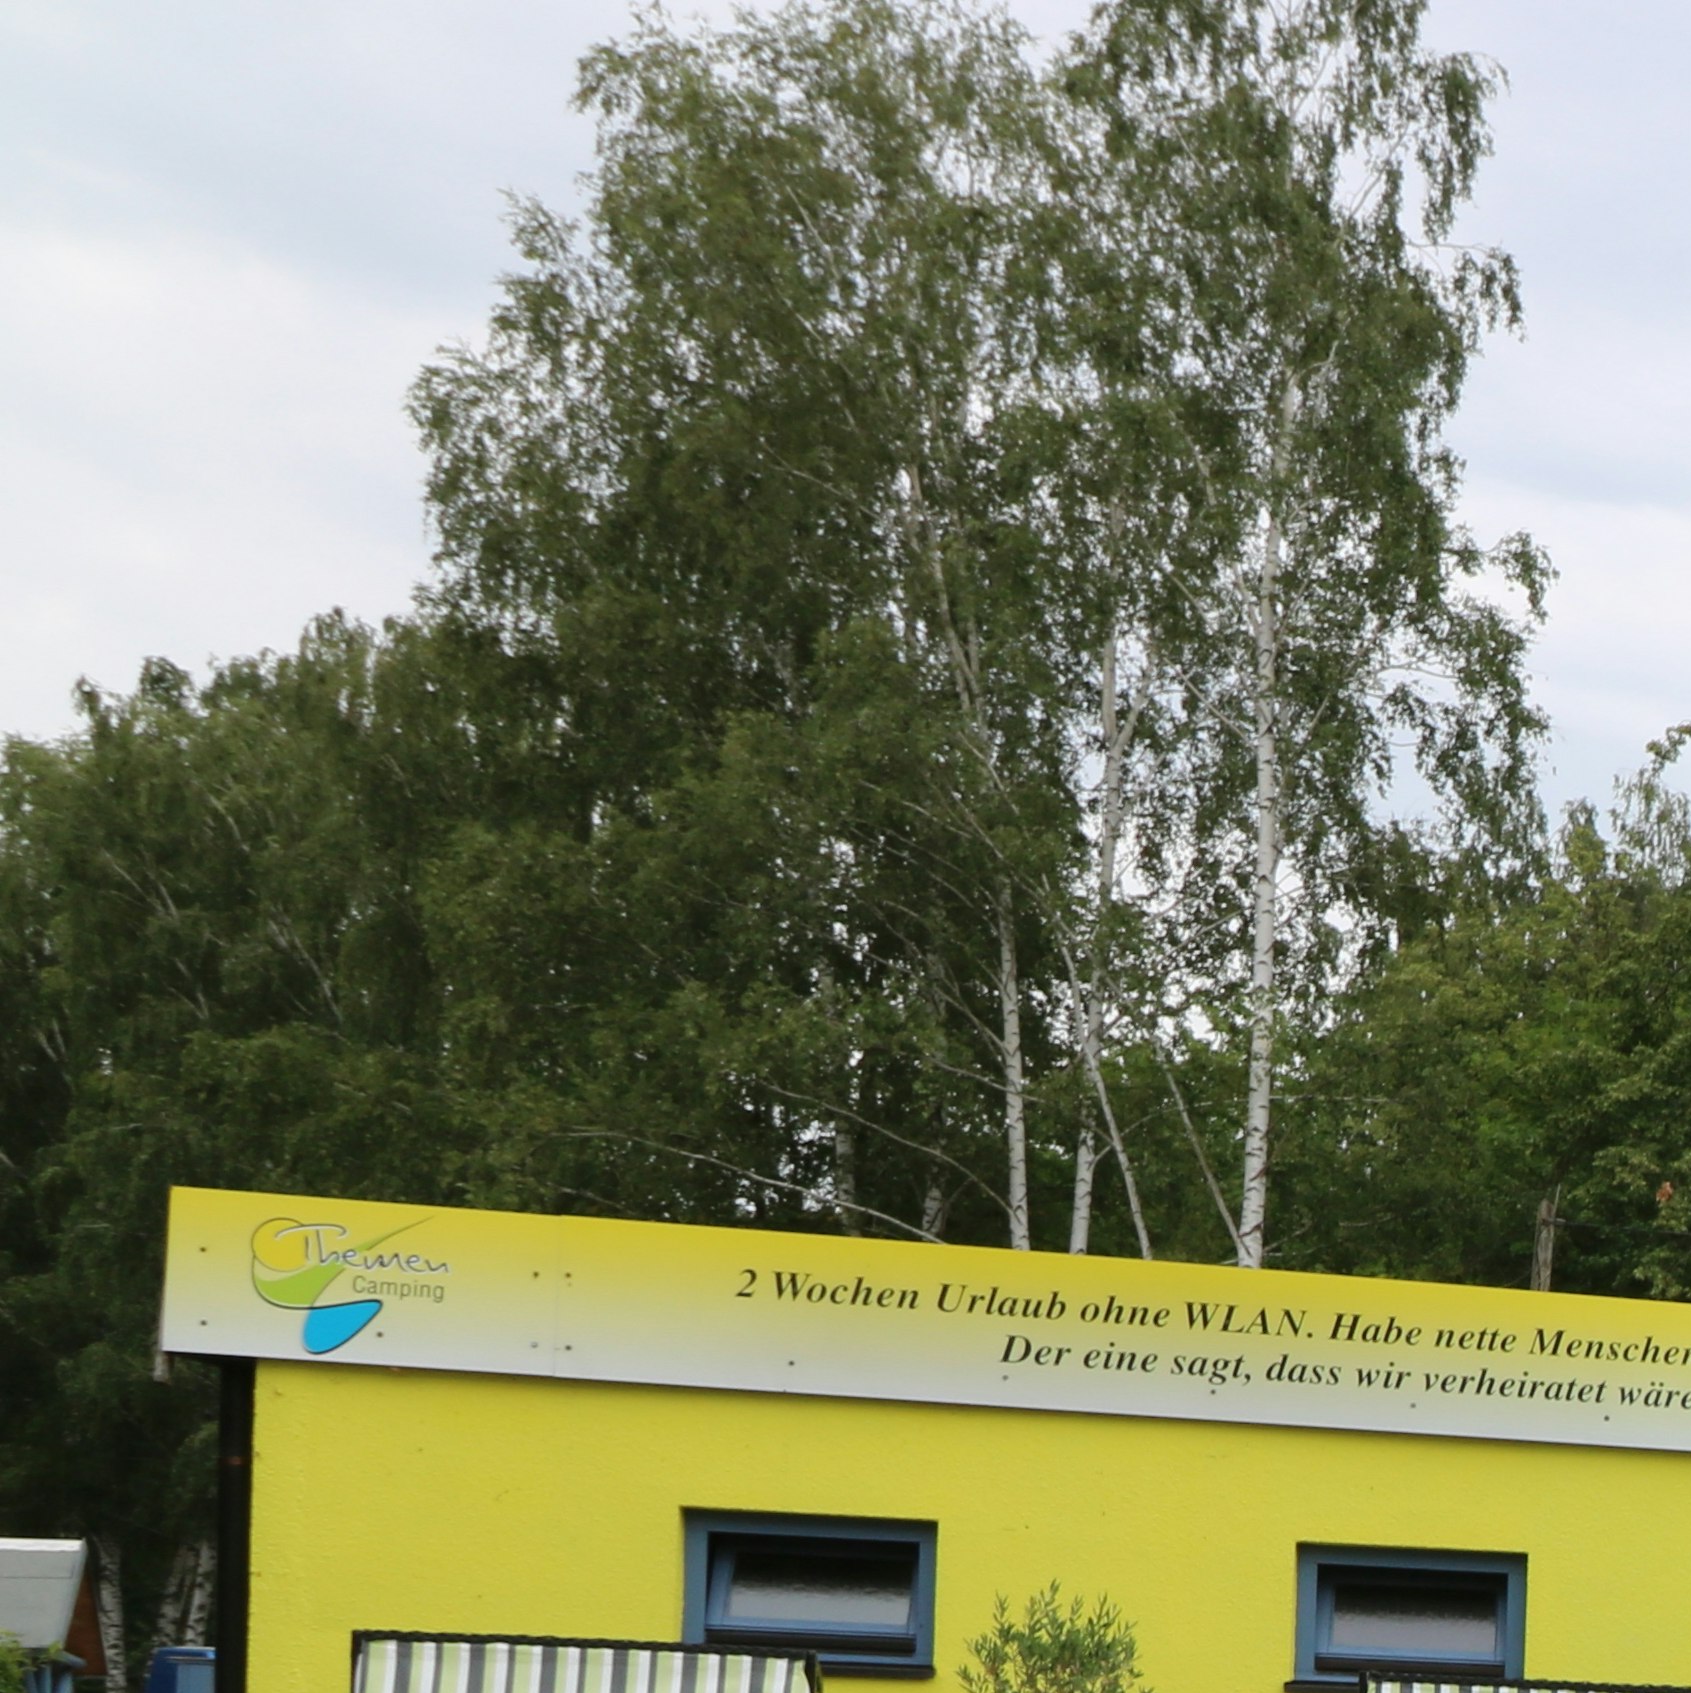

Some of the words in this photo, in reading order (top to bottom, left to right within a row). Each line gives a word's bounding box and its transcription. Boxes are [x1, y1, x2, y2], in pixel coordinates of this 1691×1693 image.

[274, 1223, 449, 1273] Themen
[352, 1275, 445, 1304] Camping
[736, 1268, 758, 1299] 2
[772, 1269, 920, 1310] Wochen
[936, 1282, 1068, 1320] Urlaub
[1079, 1293, 1172, 1328] ohne
[1184, 1300, 1314, 1341] WLAN.
[1328, 1312, 1423, 1347] Habe
[1433, 1327, 1518, 1355] nette
[1001, 1333, 1075, 1366] Der
[1082, 1343, 1161, 1374] eine
[1169, 1355, 1254, 1386] sagt,
[1264, 1353, 1343, 1388] dass
[1354, 1362, 1413, 1392] wir
[1421, 1366, 1609, 1406] verheiratet
